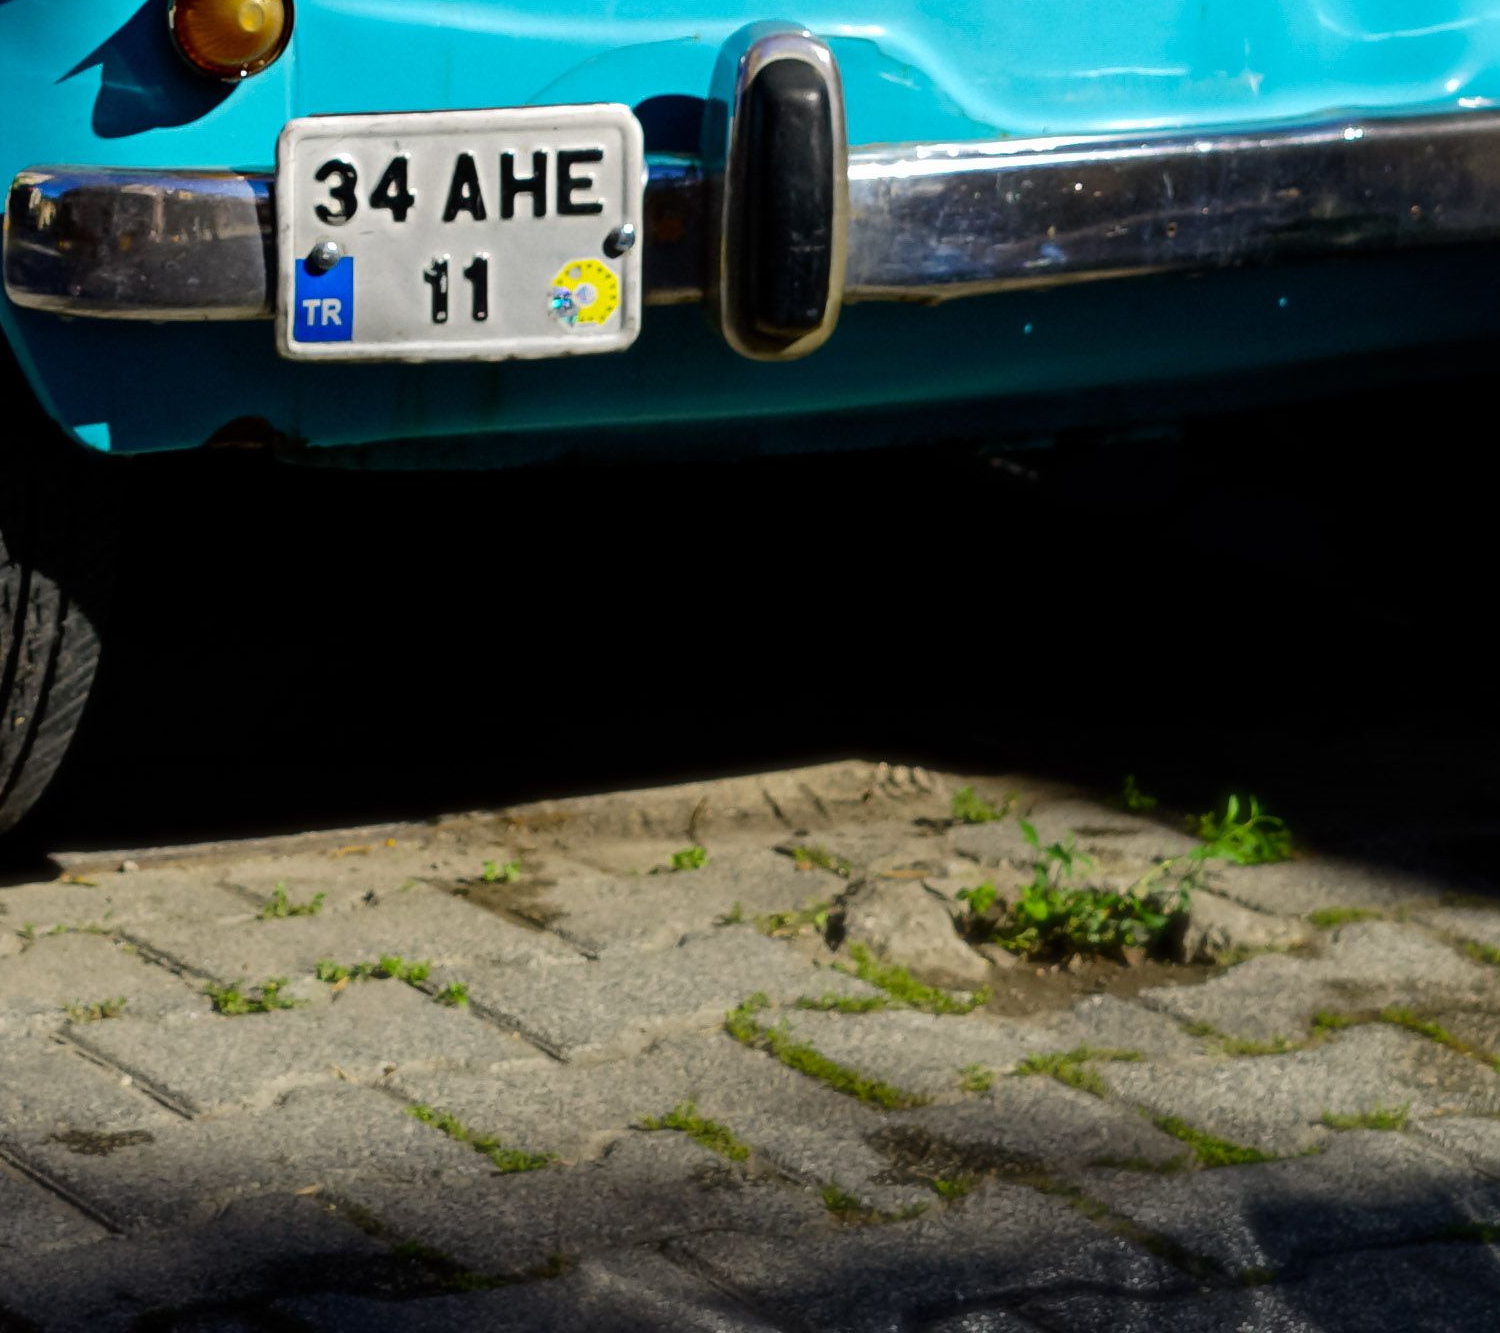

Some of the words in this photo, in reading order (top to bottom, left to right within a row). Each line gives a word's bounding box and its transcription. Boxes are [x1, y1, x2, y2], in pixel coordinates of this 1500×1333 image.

[314, 152, 416, 226] 34
[442, 146, 604, 222] AHE
[303, 298, 342, 326] TR
[423, 252, 490, 324] 11
